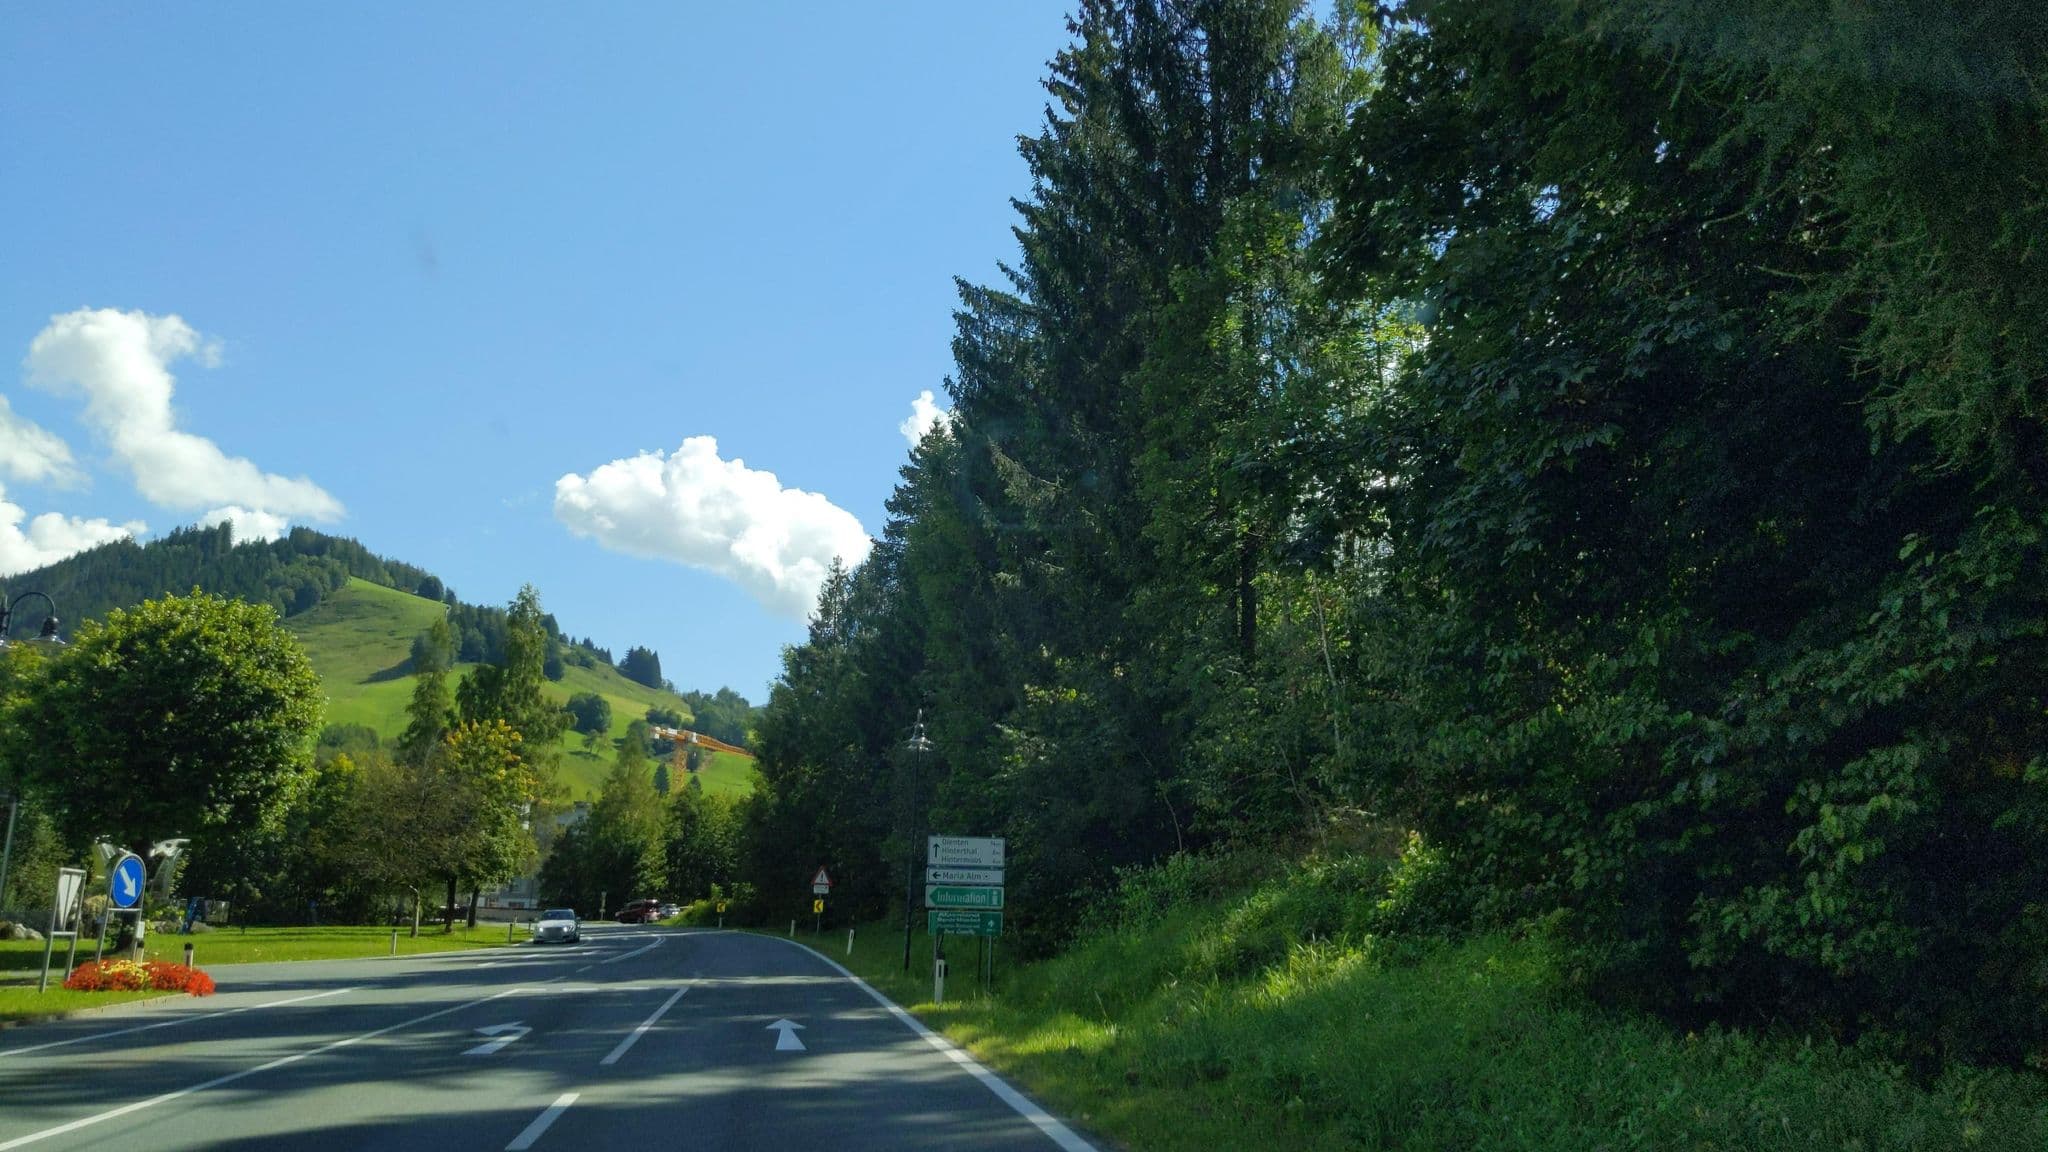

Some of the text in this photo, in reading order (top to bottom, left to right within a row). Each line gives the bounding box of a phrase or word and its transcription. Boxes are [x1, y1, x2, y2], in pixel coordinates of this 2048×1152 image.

[942, 872, 982, 880] Maria Alm
[937, 890, 986, 905] Information
